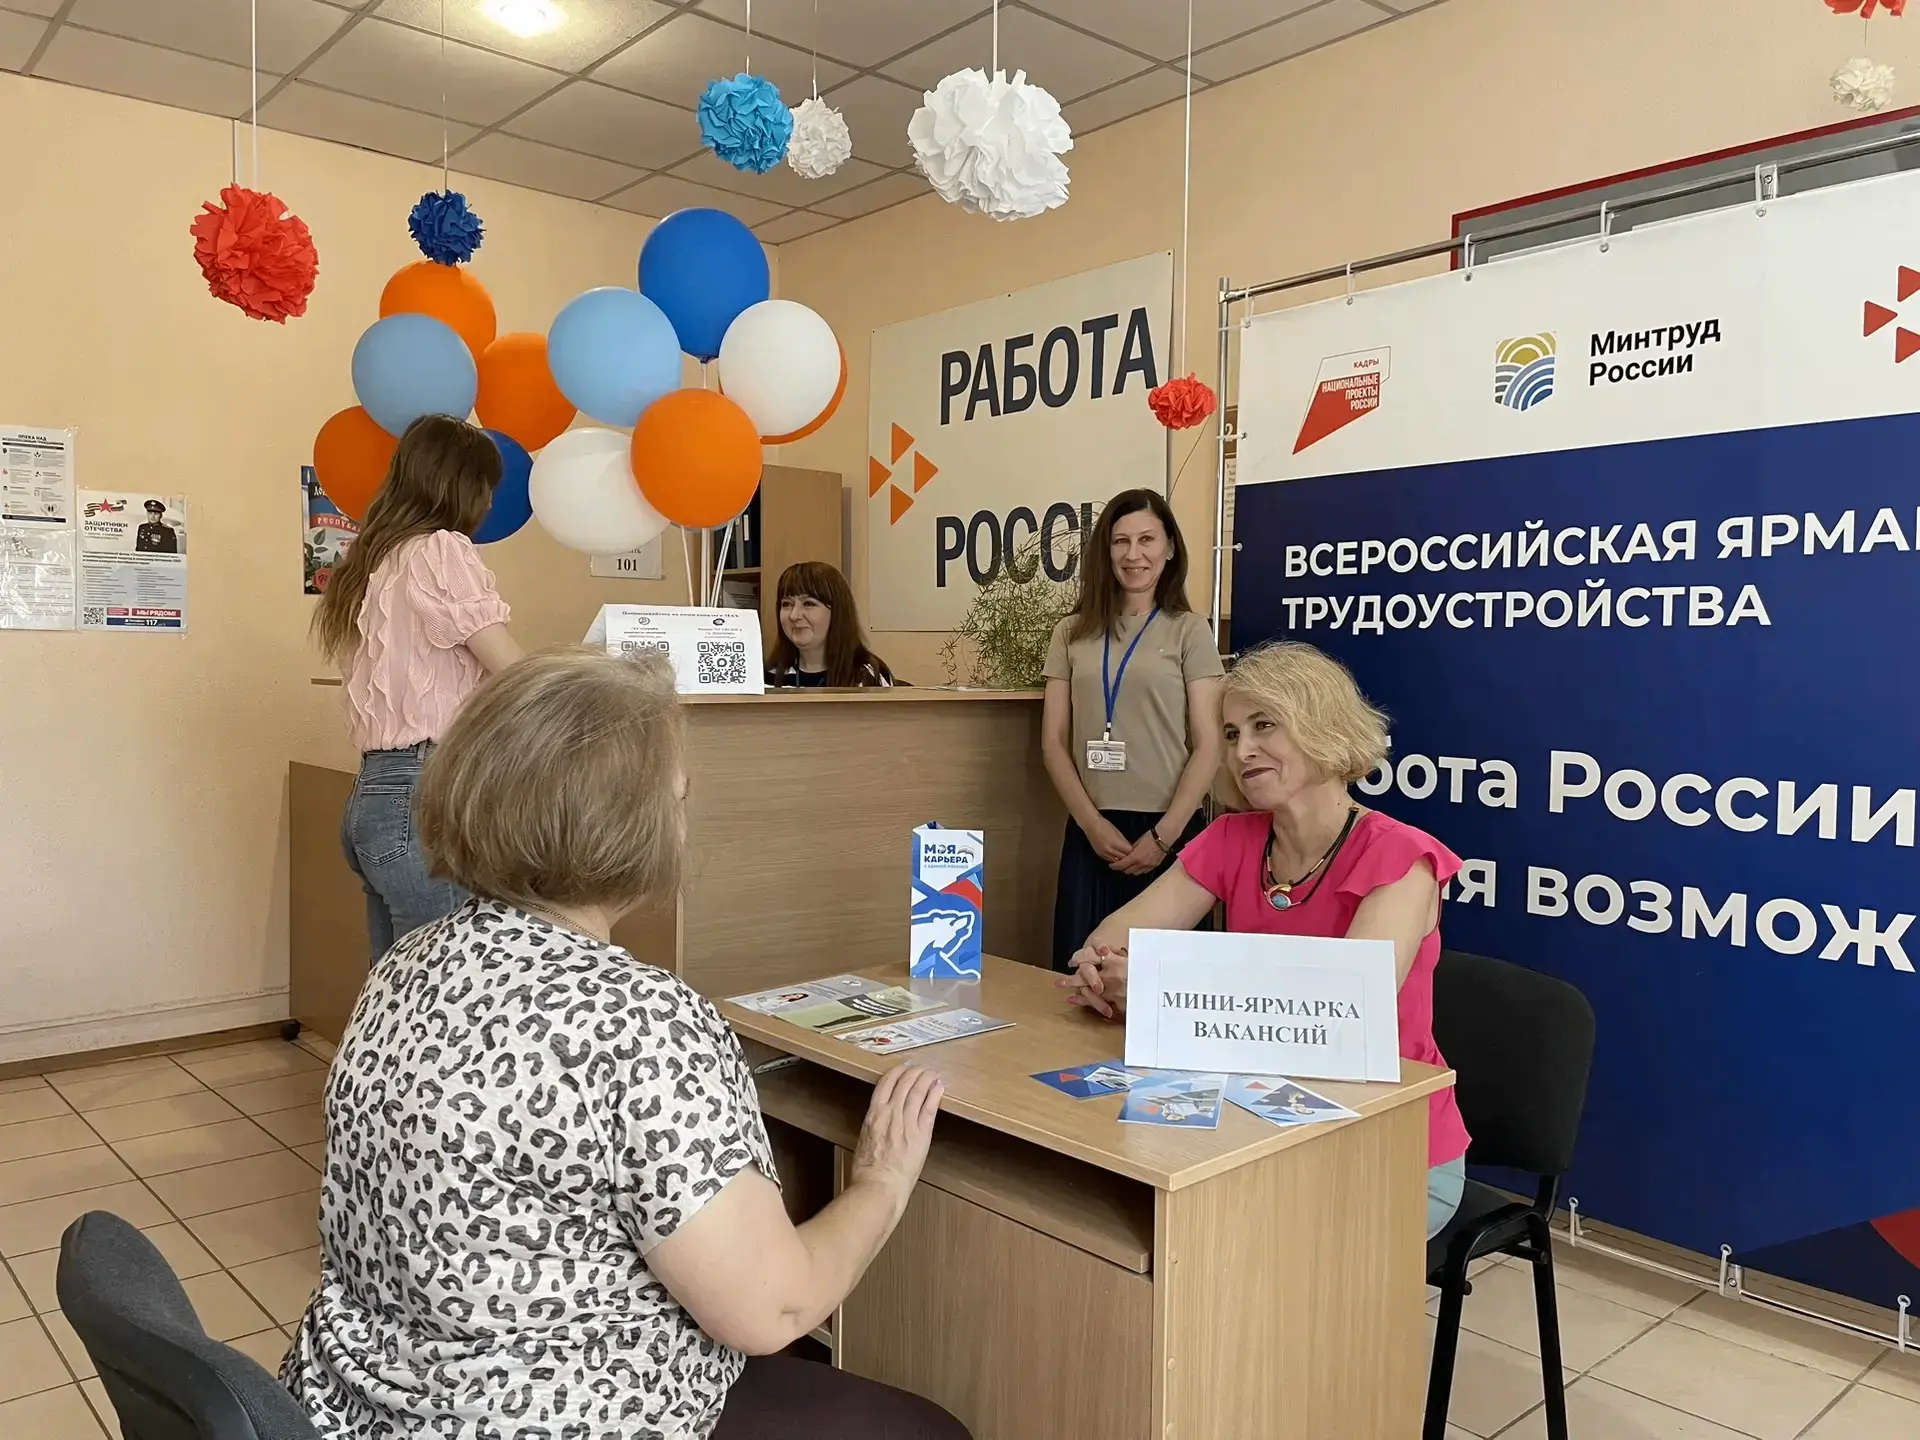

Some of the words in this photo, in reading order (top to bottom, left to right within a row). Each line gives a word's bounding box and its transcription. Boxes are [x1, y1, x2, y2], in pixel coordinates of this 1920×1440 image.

[1589, 318, 1721, 357] Минтруд
[940, 307, 1158, 425] РАБОТА
[1353, 358, 1380, 368] КАДРЫ
[1588, 353, 1694, 386] России
[1321, 373, 1379, 393] НАЦИОНАЛЬНЫЕ
[1345, 386, 1379, 400] ПРОЕКТЫ
[1350, 397, 1378, 411] РОССИИ
[84, 520, 128, 528] ЗАЩИТНИКИ
[1284, 520, 1697, 578] ВСЕРОССИЙСКАЯ
[1716, 506, 1920, 559] ЯРМА
[617, 558, 637, 571] 101
[1282, 579, 1772, 635] ТРУДОУСТРОЙСТВА
[1549, 750, 1916, 847] России
[924, 844, 956, 854] МОЯ
[924, 855, 969, 863] КАРЬЕРА
[1442, 858, 1497, 907] я
[1527, 865, 1917, 973] возмож
[1162, 991, 1361, 1020] МИНИ-ЯРМАРКА
[1193, 1020, 1329, 1046] ВАКАНСИЙ
